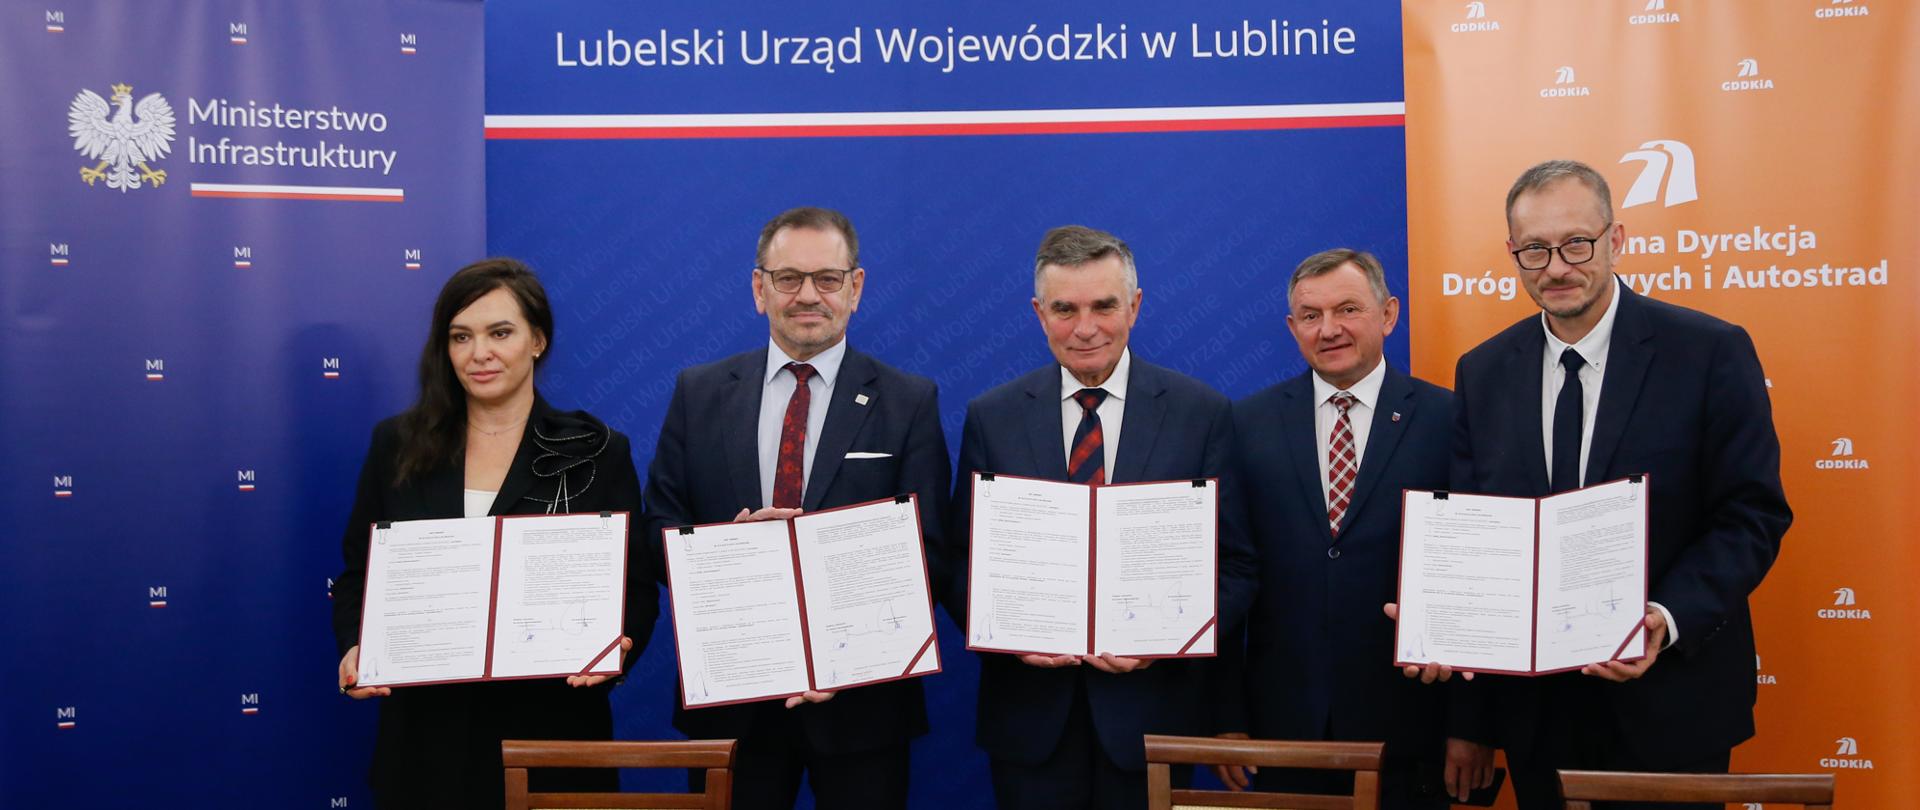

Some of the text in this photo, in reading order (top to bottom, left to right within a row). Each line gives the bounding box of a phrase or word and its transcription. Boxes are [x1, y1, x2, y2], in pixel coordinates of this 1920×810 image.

[46, 11, 64, 22] MI
[1815, 6, 1869, 17] GDDKiA
[1629, 13, 1680, 24] GDDKiA
[230, 23, 247, 34] MI
[1451, 21, 1500, 32] GDDKiA
[401, 34, 416, 44] MI
[556, 20, 1356, 73] Lubelski Urząd Wojewódzki w Lublinie
[1722, 79, 1774, 90] GDDKiA
[1540, 86, 1590, 97] GDDKiA
[188, 97, 387, 132] Ministerstwo
[189, 137, 397, 175] Infrastruktury
[1677, 225, 1817, 260] Dyrekcja
[51, 244, 69, 255] MI
[234, 247, 251, 257] MI
[405, 249, 421, 260] MI
[1442, 271, 1517, 300] Dróg
[1704, 264, 1712, 289] i
[1722, 259, 1888, 289] Autostrad
[146, 359, 163, 370] MI
[323, 358, 339, 368] MI
[1815, 459, 1869, 469] GDDKiA
[238, 470, 255, 481] MI
[54, 476, 72, 487] MI
[150, 586, 167, 597] MI
[1818, 608, 1871, 619] GDDKiA
[242, 693, 259, 704] MI
[58, 707, 76, 718] MI
[1820, 758, 1874, 768] GDDKiA
[331, 796, 348, 809] MI
